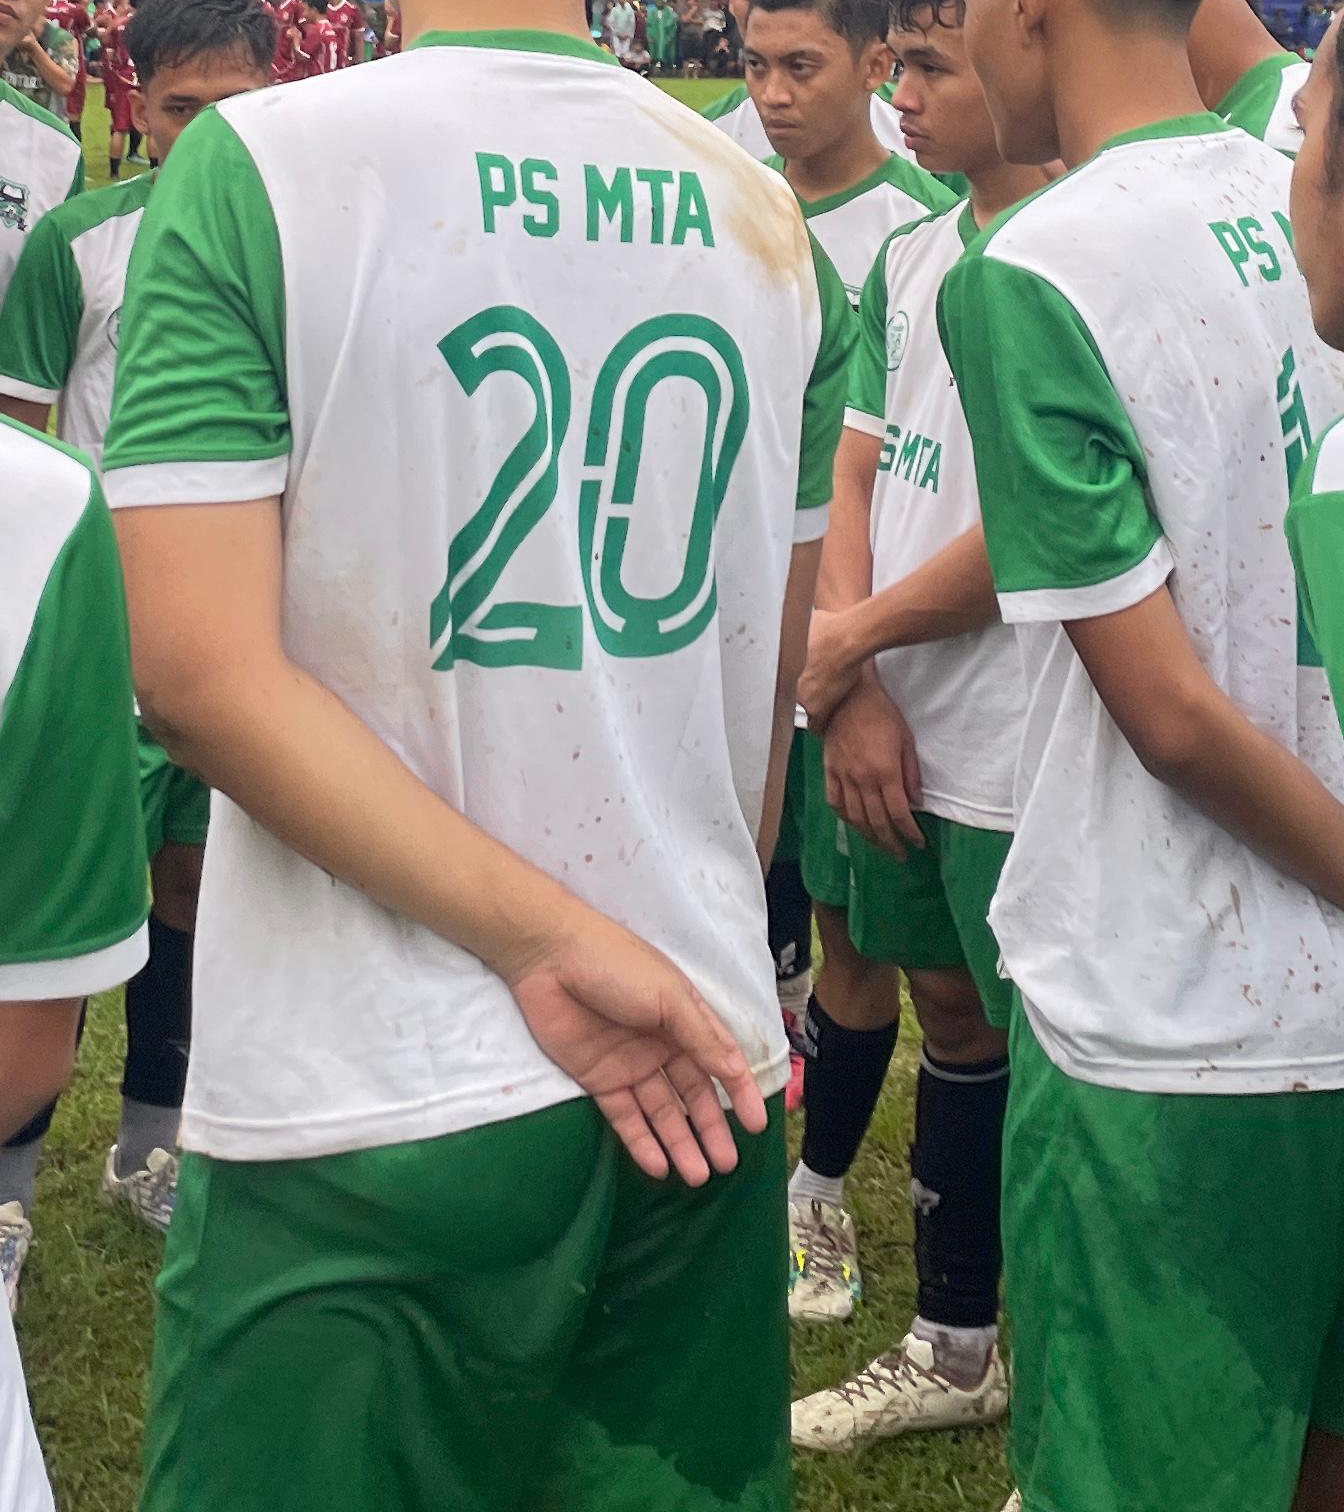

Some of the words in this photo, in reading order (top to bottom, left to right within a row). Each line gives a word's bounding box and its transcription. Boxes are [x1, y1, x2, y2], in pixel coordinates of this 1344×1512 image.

[475, 151, 561, 239] PS
[583, 163, 716, 249] MTA
[1207, 215, 1283, 287] PS
[429, 304, 751, 672] 20
[877, 423, 902, 472] S
[895, 430, 943, 495] MTA
